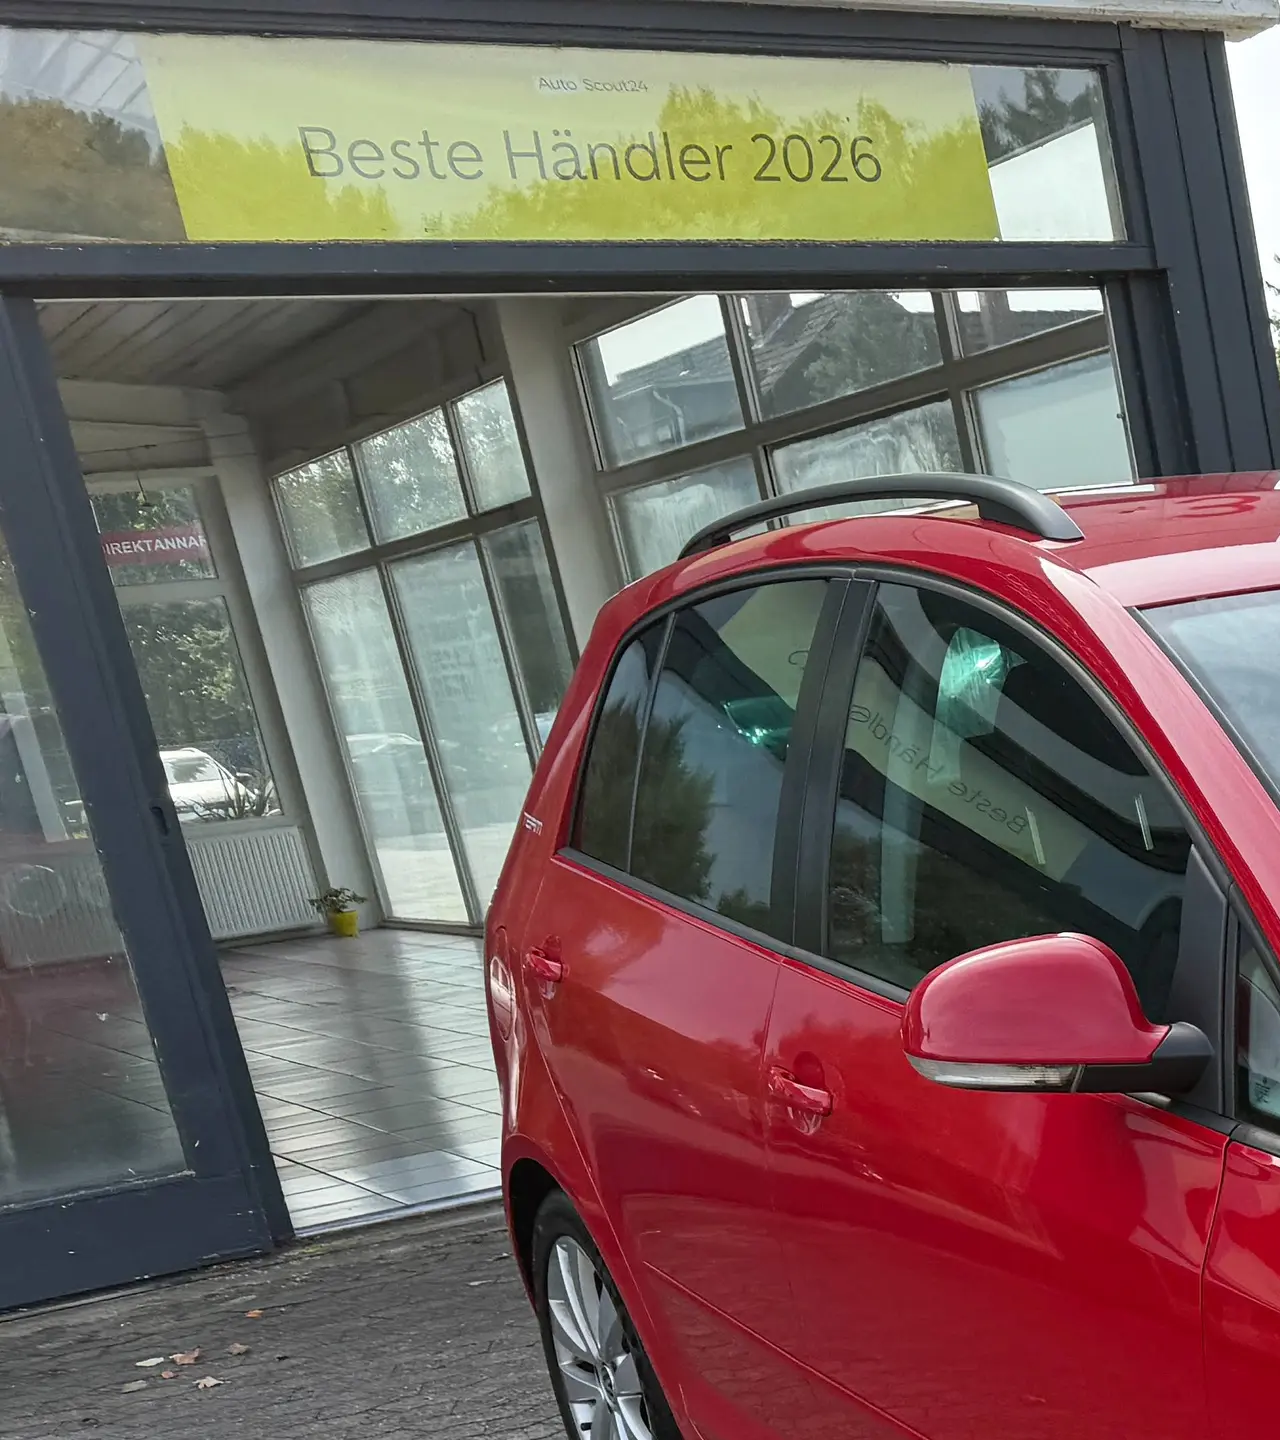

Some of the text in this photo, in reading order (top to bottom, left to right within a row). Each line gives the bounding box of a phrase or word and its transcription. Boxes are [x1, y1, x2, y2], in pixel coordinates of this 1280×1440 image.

[538, 77, 648, 92] Auto Scout24
[298, 126, 882, 183] Beste Händler 2026
